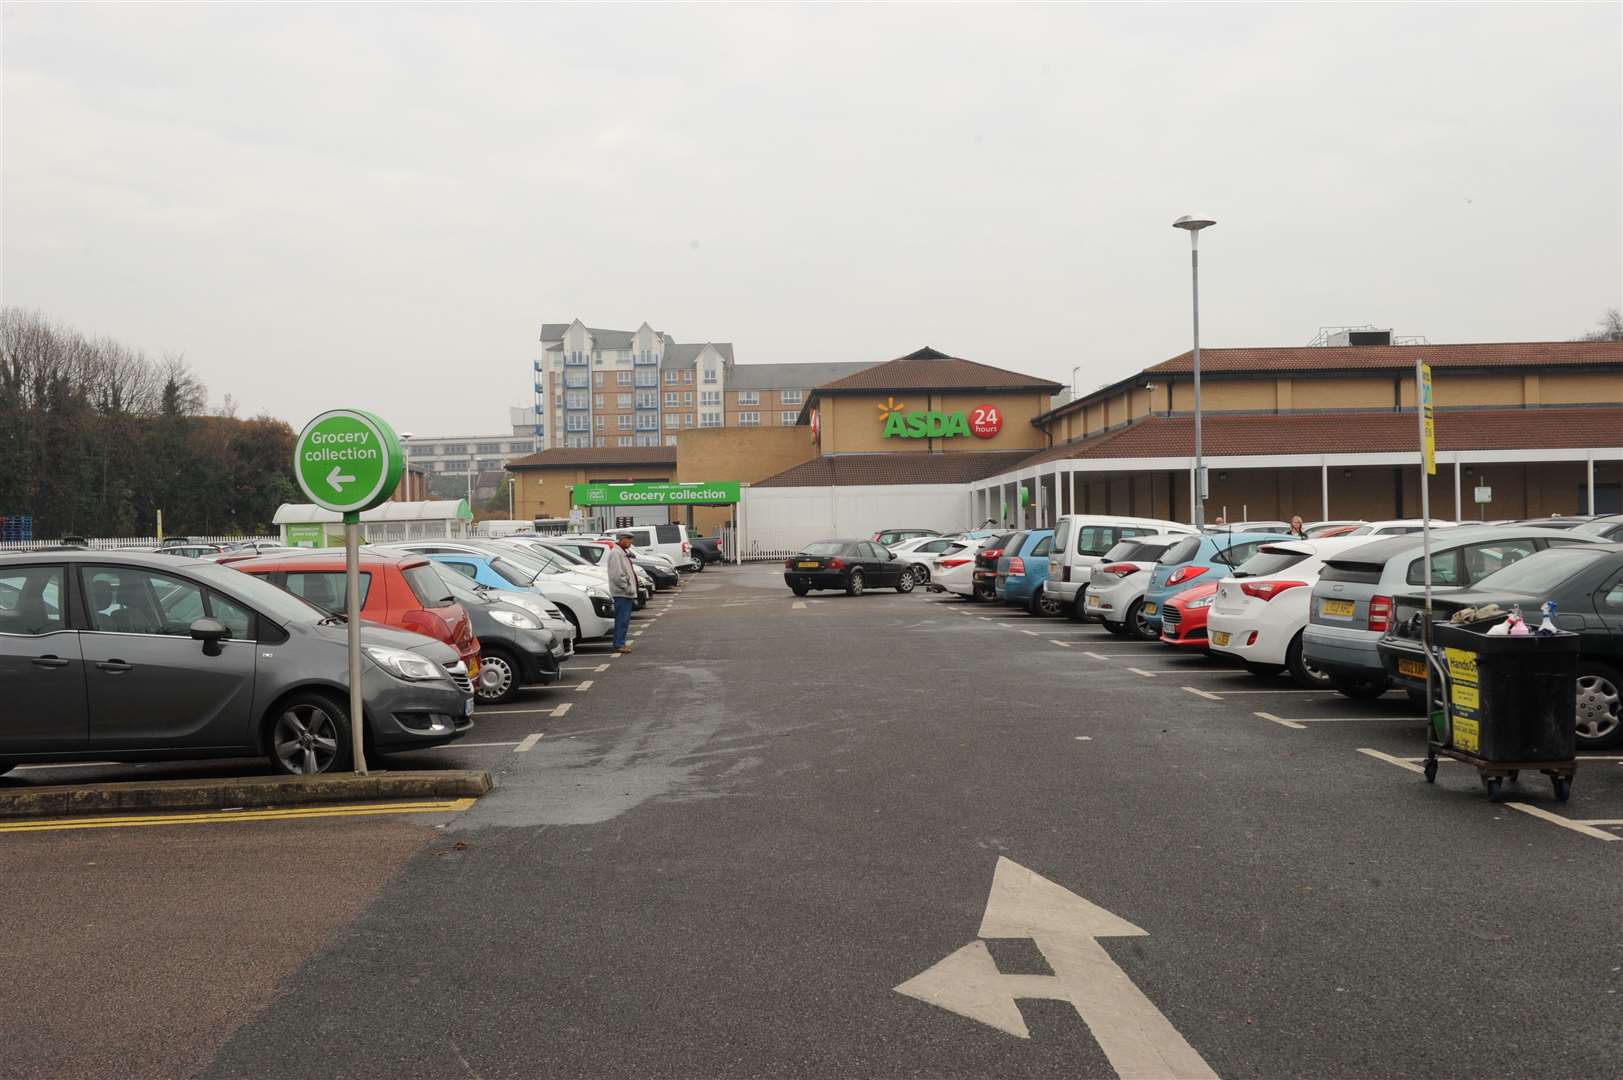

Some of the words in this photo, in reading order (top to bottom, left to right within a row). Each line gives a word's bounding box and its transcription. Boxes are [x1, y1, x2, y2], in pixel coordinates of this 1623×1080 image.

[974, 409, 998, 425] 24
[884, 411, 970, 437] ASDA
[975, 425, 998, 433] hours
[312, 432, 369, 444] Grocery
[305, 448, 376, 461] collection
[619, 491, 666, 502] Grocery
[669, 490, 726, 500] collection
